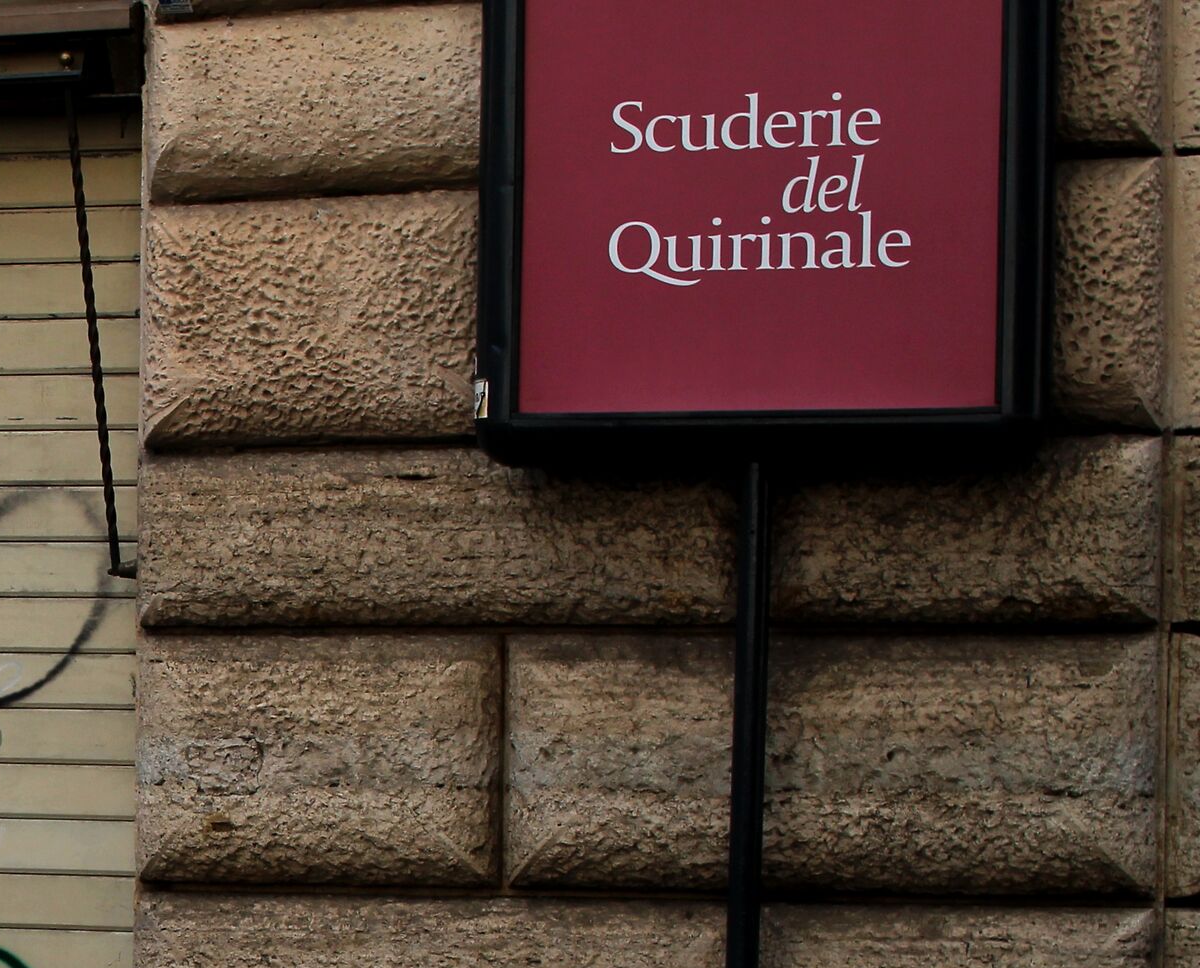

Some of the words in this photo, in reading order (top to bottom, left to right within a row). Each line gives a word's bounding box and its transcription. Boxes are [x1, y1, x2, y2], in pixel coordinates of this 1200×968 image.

[610, 92, 882, 154] Scuderie
[781, 154, 866, 214] del
[608, 211, 912, 287] Quirinale
